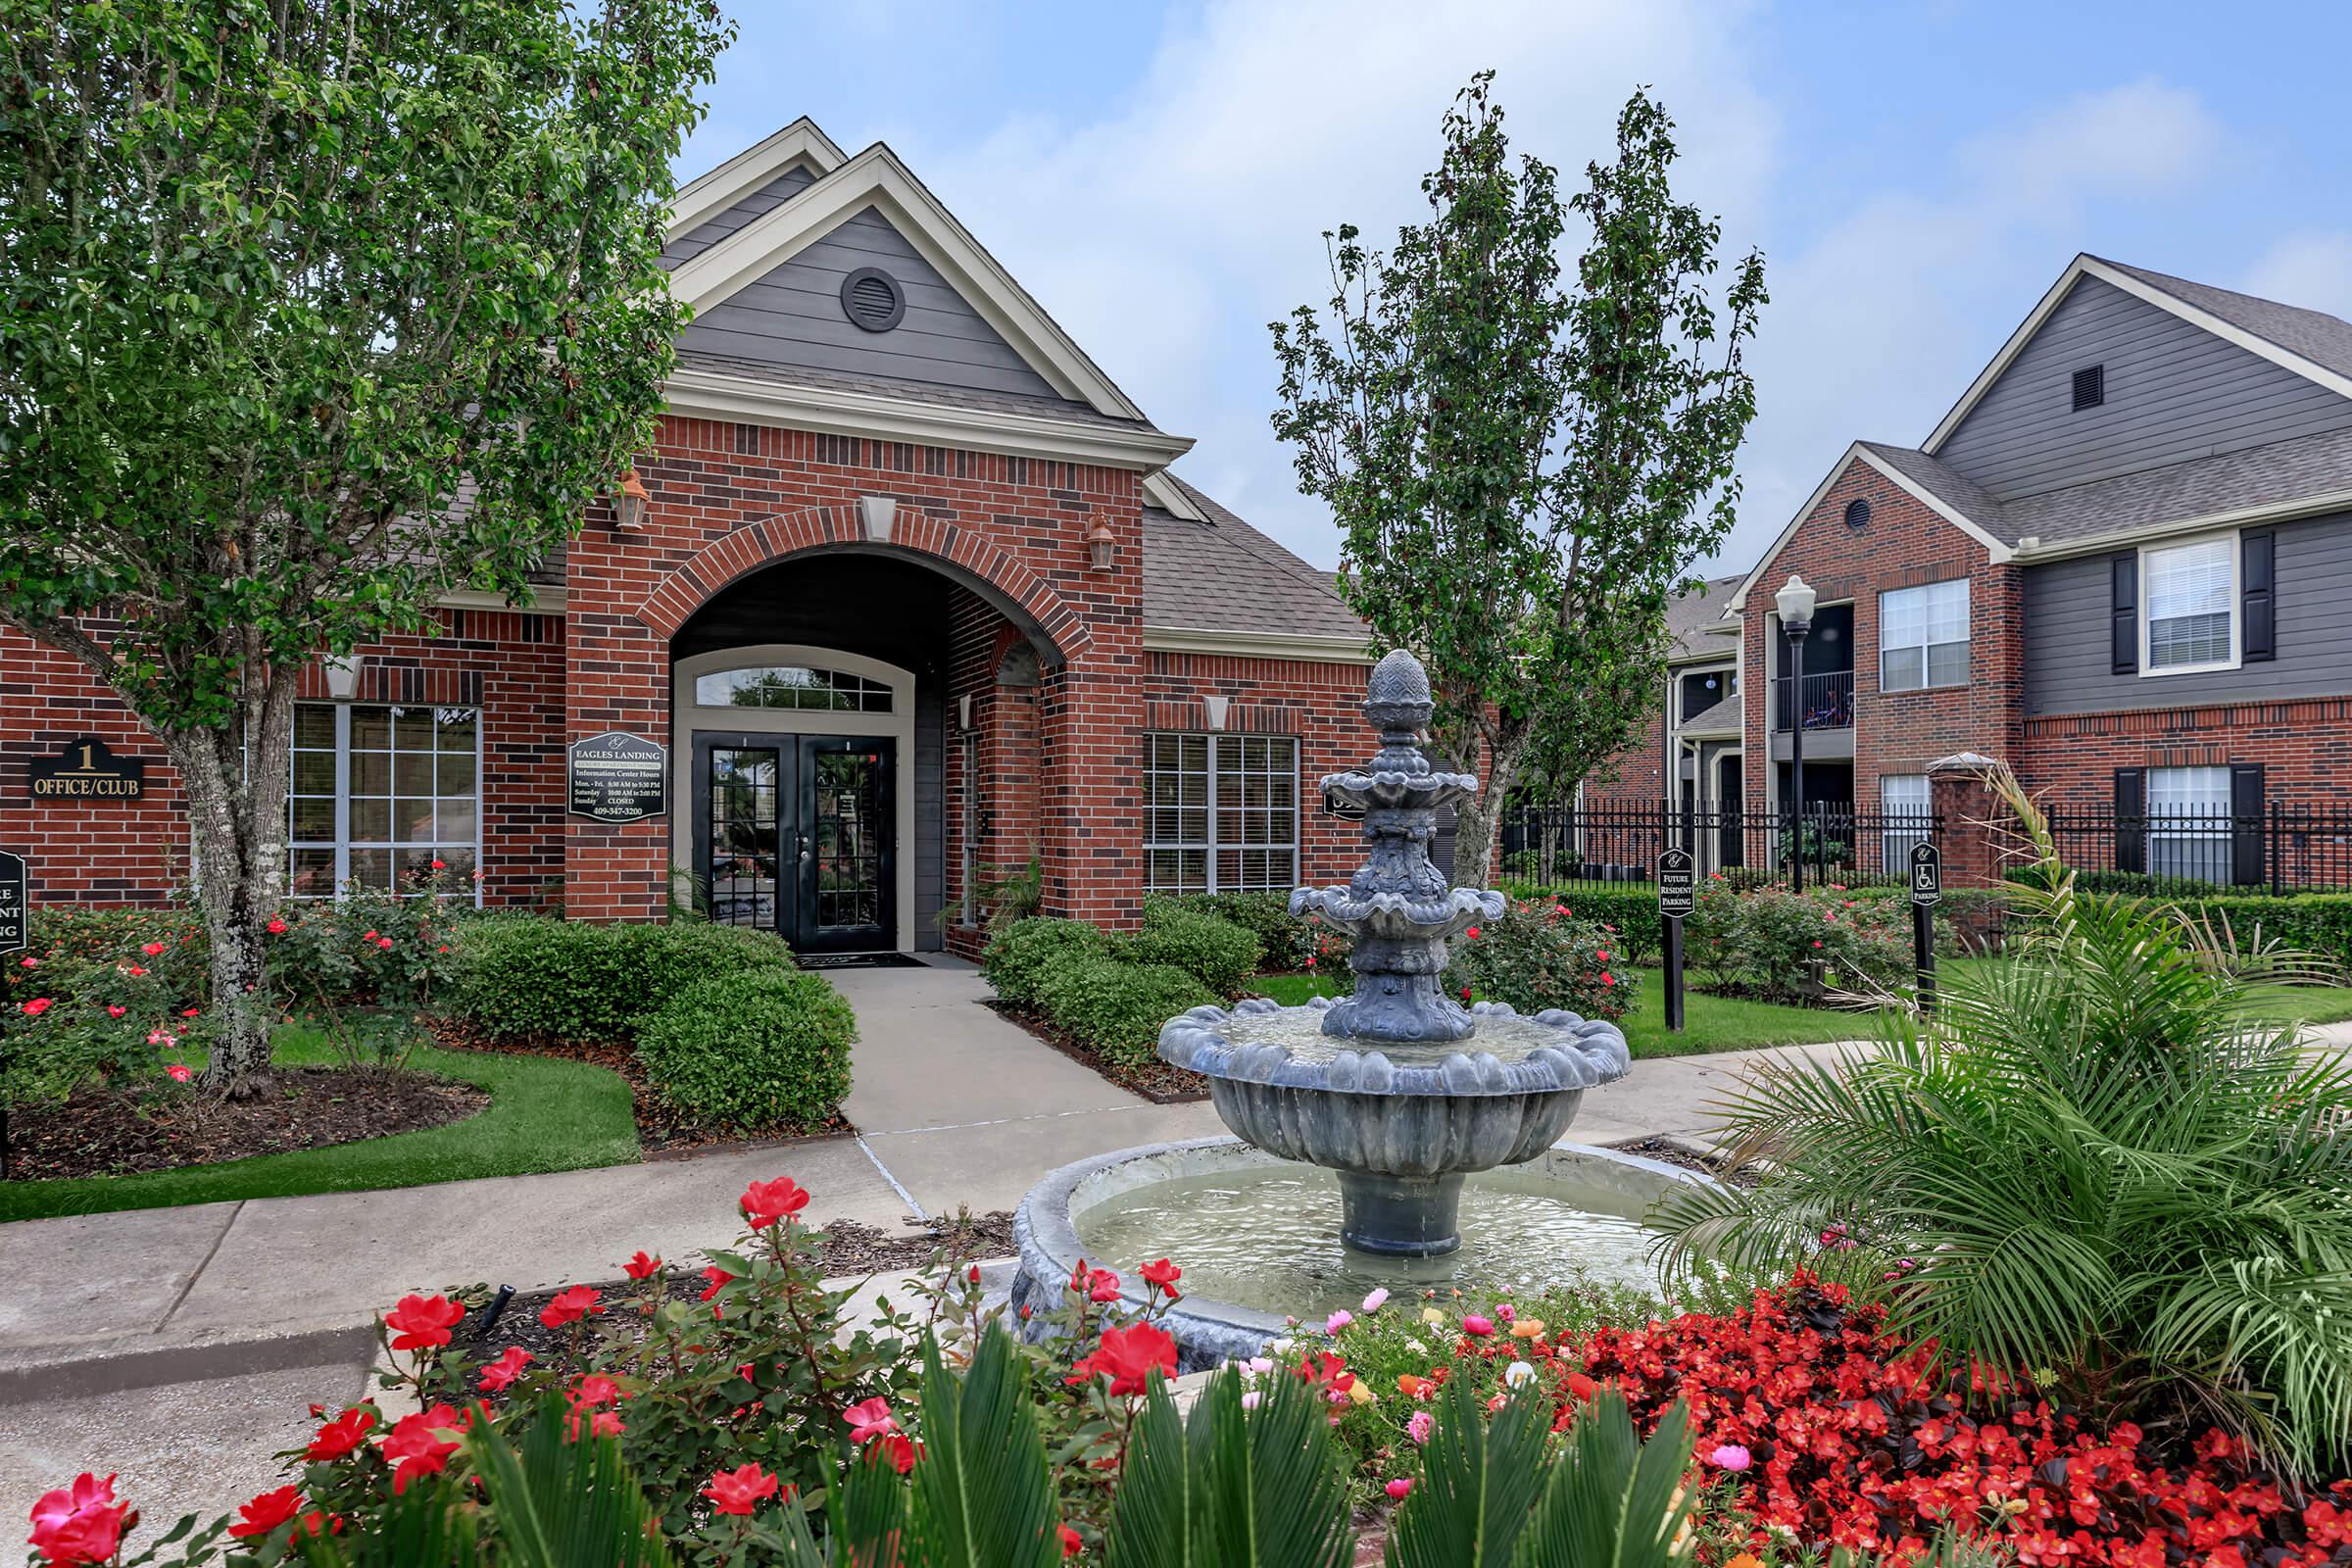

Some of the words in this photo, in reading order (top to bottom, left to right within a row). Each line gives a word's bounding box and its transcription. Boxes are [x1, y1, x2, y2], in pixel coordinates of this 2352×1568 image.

[78, 745, 96, 769] 1
[614, 752, 660, 760] LANDING
[34, 778, 138, 796] OFFICE/CLUB
[593, 807, 643, 815] 409-347-3200
[1663, 874, 1690, 883] FUTURE
[1660, 886, 1692, 895] RESIDENT
